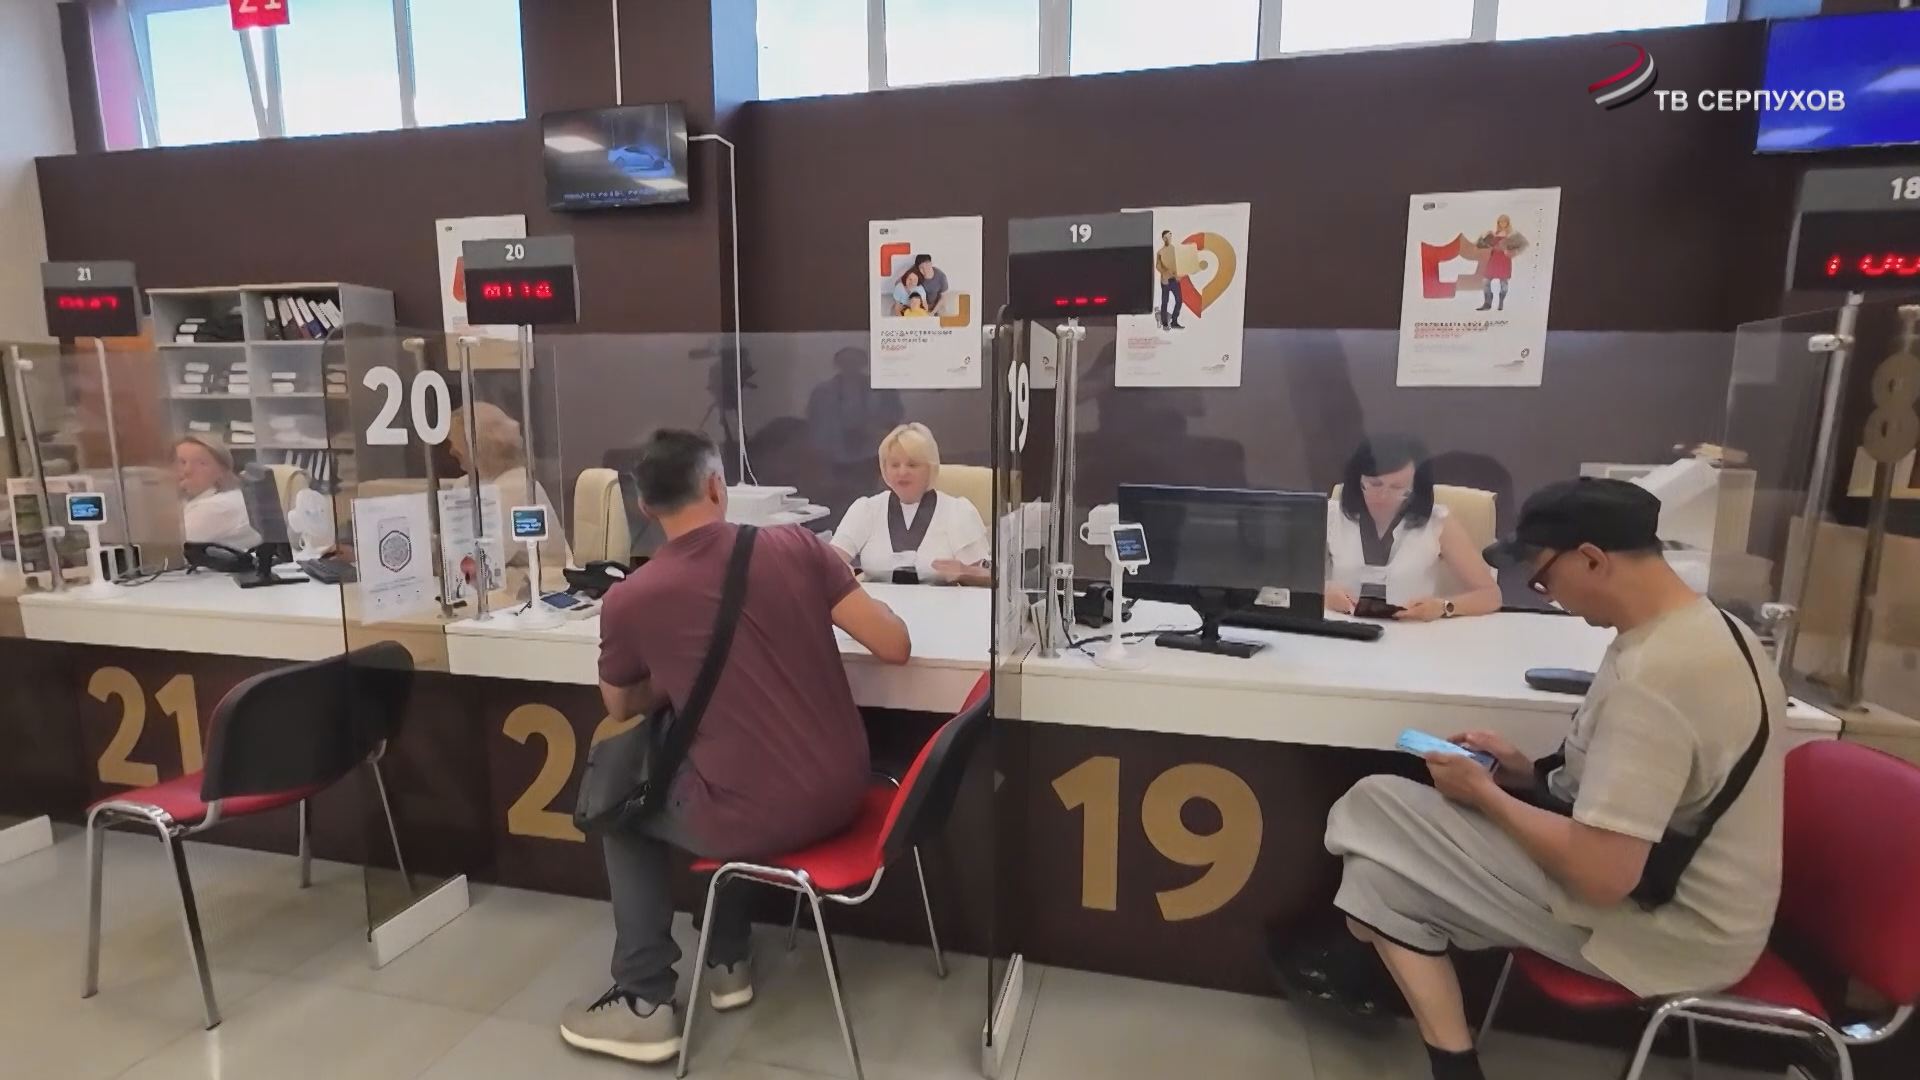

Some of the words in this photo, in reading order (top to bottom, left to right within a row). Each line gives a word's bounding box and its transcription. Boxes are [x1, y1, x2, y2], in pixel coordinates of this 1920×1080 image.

[1891, 175, 1920, 200] 18
[504, 243, 525, 261] 20
[1069, 224, 1092, 243] 19
[77, 267, 92, 281] 21
[362, 366, 452, 446] 20
[1008, 360, 1030, 453] 19
[87, 665, 205, 787] 21
[1051, 756, 1263, 922] 19
